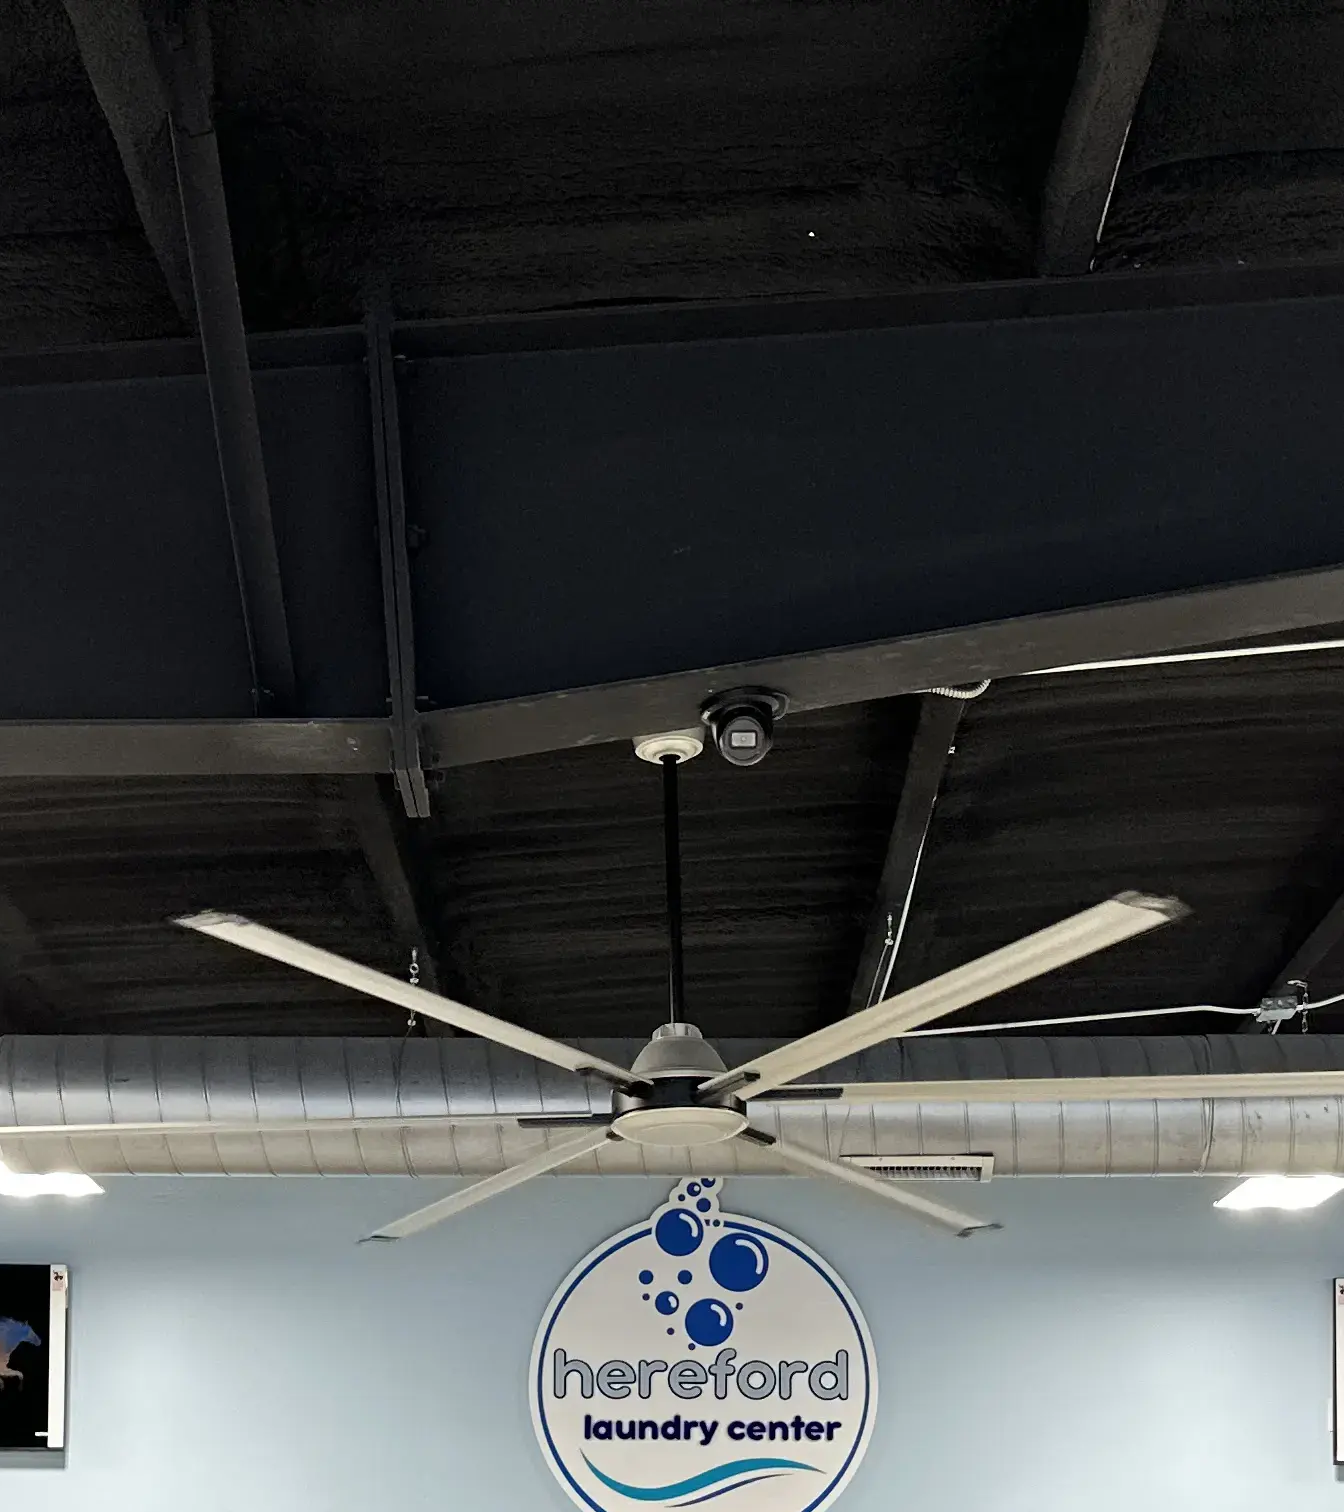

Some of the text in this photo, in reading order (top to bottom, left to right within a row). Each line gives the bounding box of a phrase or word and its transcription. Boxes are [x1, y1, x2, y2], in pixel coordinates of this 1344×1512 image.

[553, 1347, 849, 1400] hereford
[584, 1414, 842, 1445] laundry center
